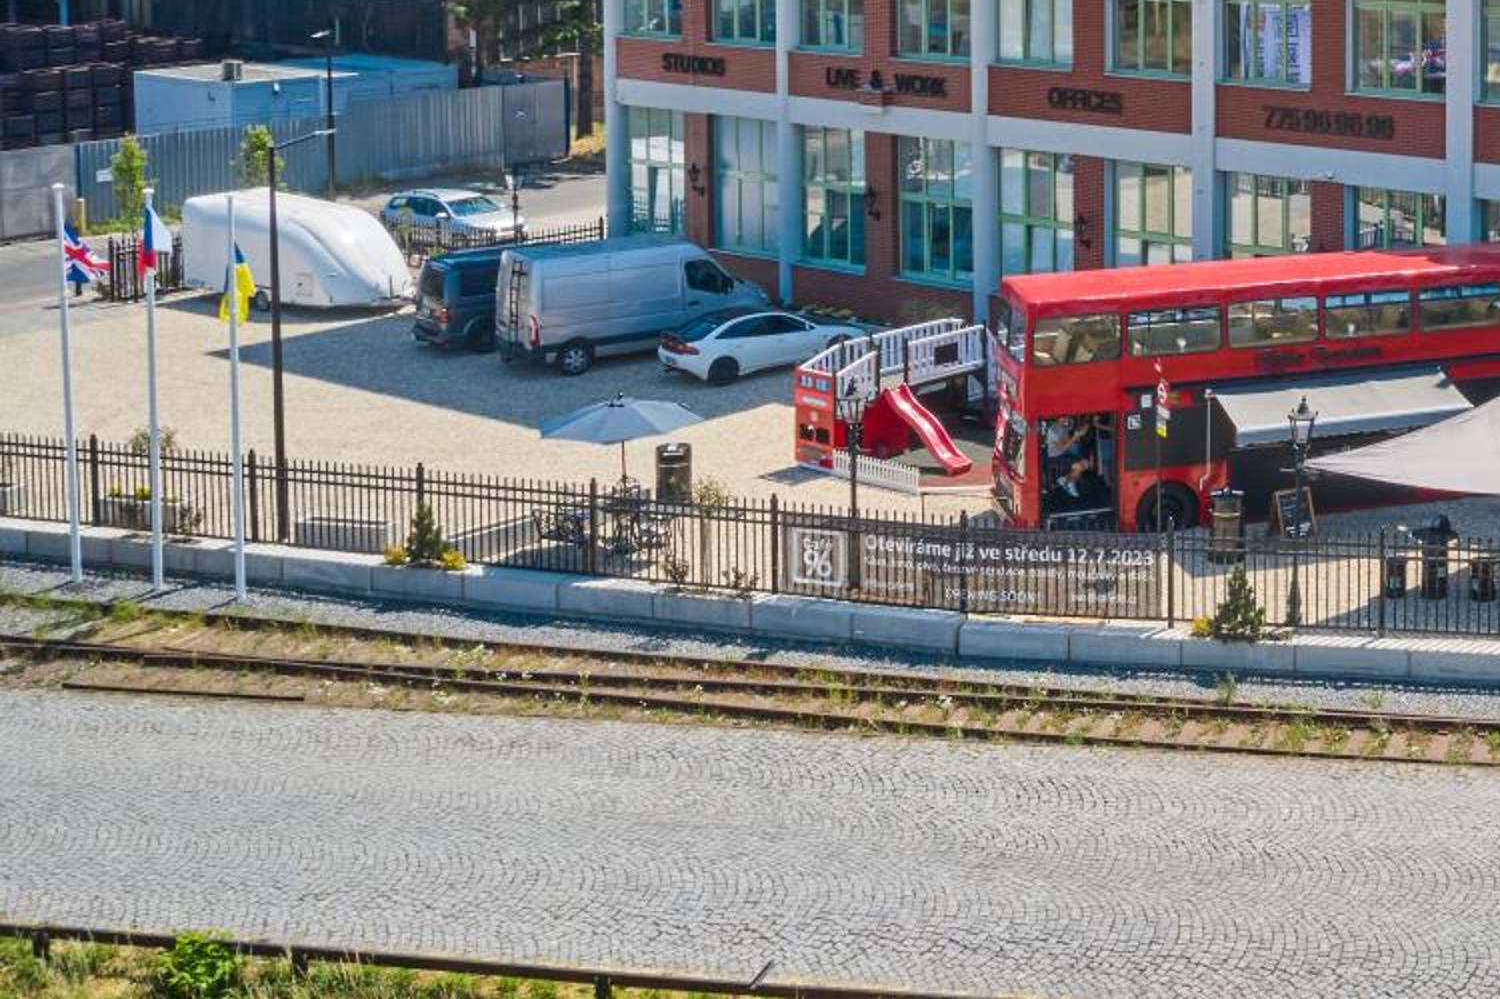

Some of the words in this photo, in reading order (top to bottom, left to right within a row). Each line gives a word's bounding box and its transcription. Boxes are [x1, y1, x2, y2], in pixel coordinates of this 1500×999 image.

[661, 52, 727, 77] STUDIOS
[825, 66, 861, 90] LIVE
[894, 72, 948, 98] WORK
[1047, 86, 1122, 115] OFFICES
[979, 548, 1000, 561] ve
[1004, 545, 1063, 562] středu
